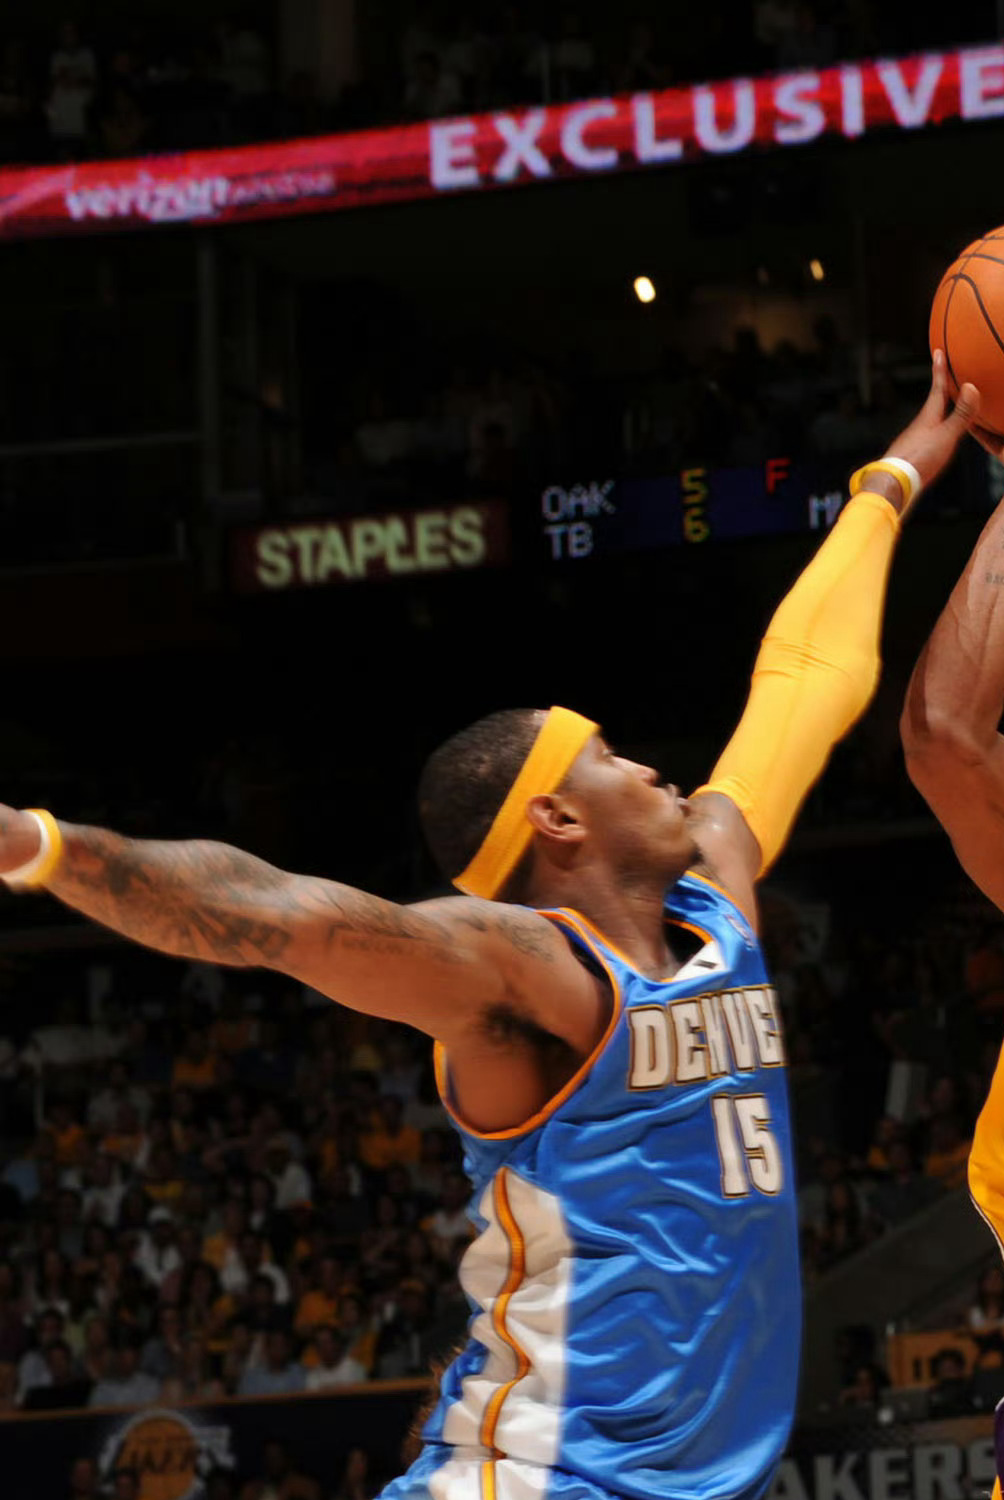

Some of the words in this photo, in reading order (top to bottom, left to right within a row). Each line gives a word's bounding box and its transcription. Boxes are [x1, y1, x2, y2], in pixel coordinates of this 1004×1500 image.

[542, 479, 616, 521] OAK
[681, 467, 708, 504] 5
[764, 457, 792, 495] F
[255, 505, 486, 590] STAPLES
[545, 520, 595, 560] TB
[683, 507, 711, 543] 6
[626, 984, 785, 1091] DENVE
[711, 1093, 784, 1198] 15
